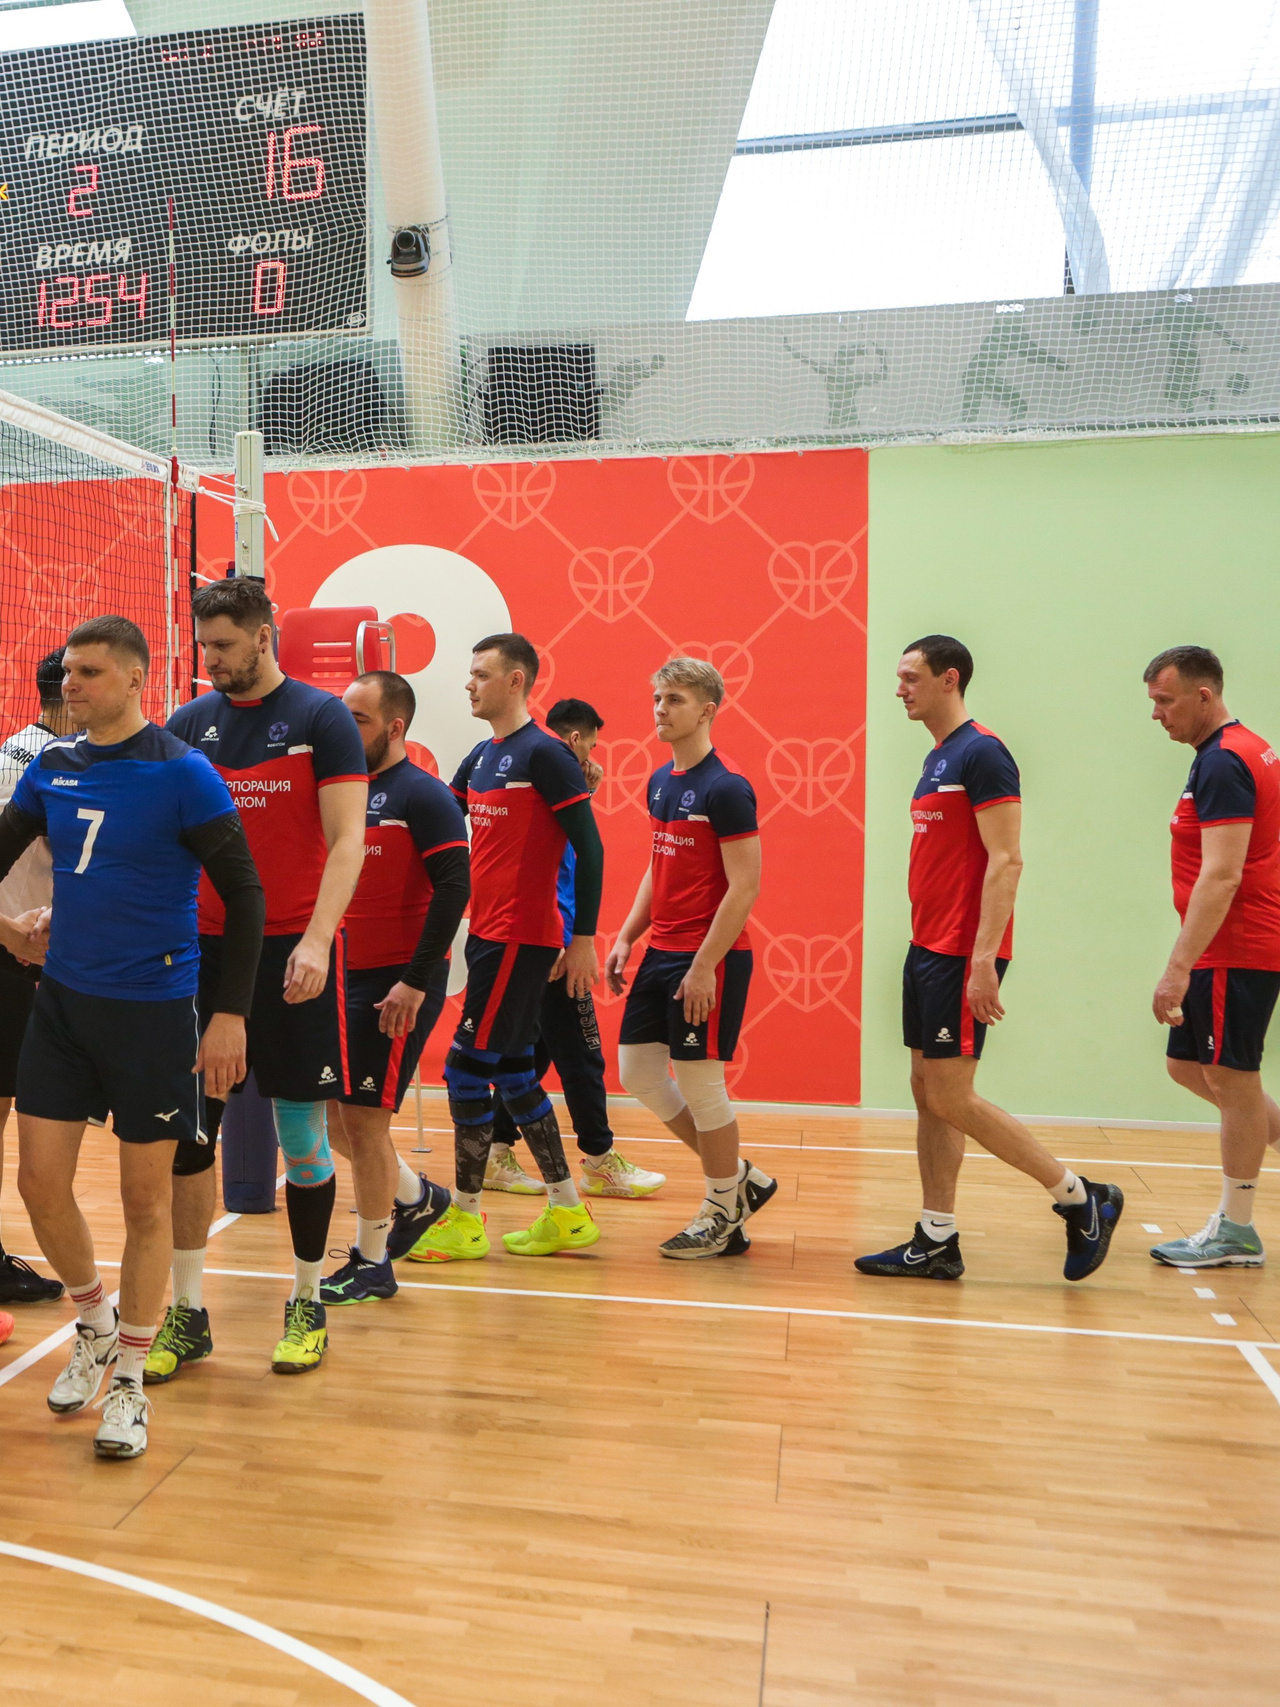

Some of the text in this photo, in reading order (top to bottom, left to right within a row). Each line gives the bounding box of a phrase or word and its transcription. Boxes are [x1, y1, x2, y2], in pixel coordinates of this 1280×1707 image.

[25, 124, 144, 160] ПЕРИОД
[266, 125, 325, 200] 16
[68, 164, 98, 216] 2
[35, 237, 132, 269] ВРЕМЯ
[228, 227, 314, 255] ФОЛЫ
[254, 260, 286, 314] 0
[226, 780, 291, 794] РПОРАЦИЯ
[233, 797, 266, 808] АТОМ
[74, 808, 104, 874] 7
